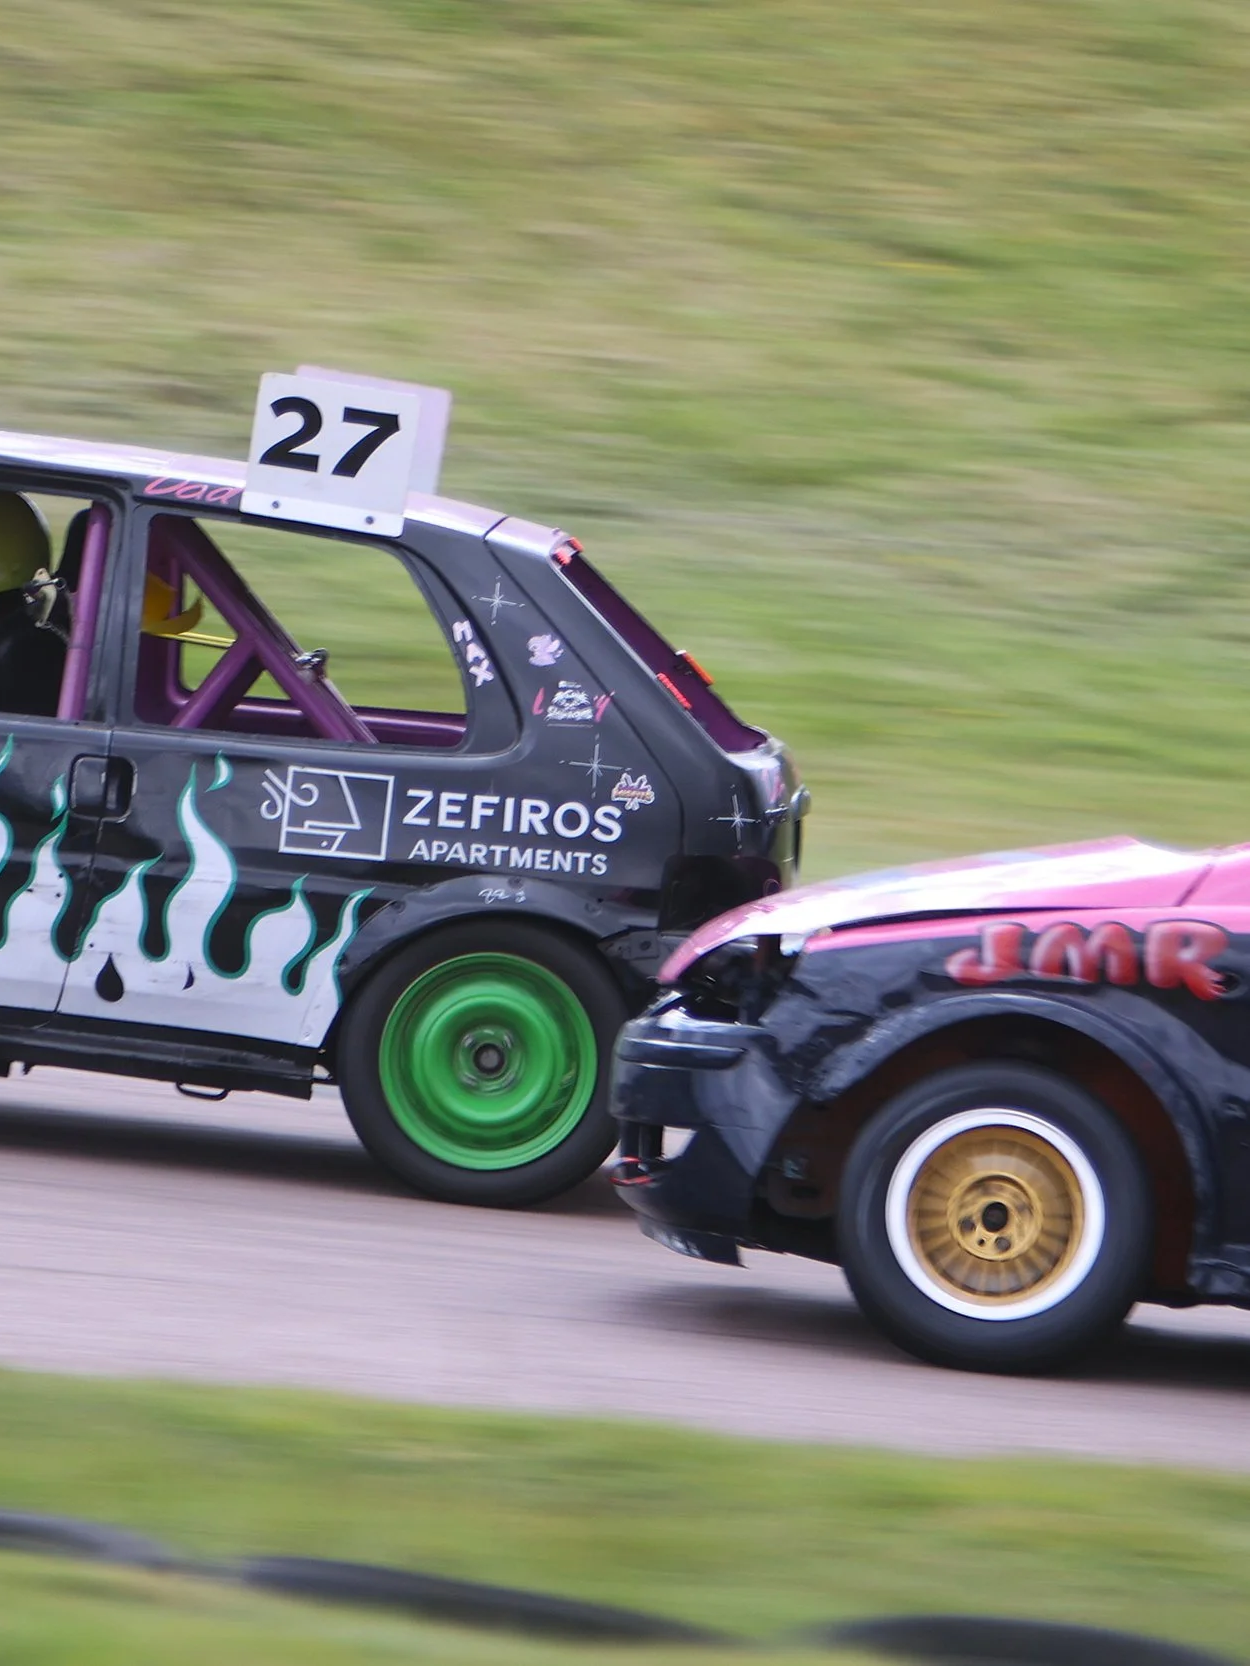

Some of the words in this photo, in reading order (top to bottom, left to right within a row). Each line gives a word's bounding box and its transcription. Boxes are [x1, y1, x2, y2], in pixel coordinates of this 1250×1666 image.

[259, 396, 401, 478] 27
[452, 620, 495, 688] MAX
[402, 789, 623, 843] ZEFIROS
[407, 839, 608, 875] APARTMENTS
[944, 919, 1230, 1001] JMR
